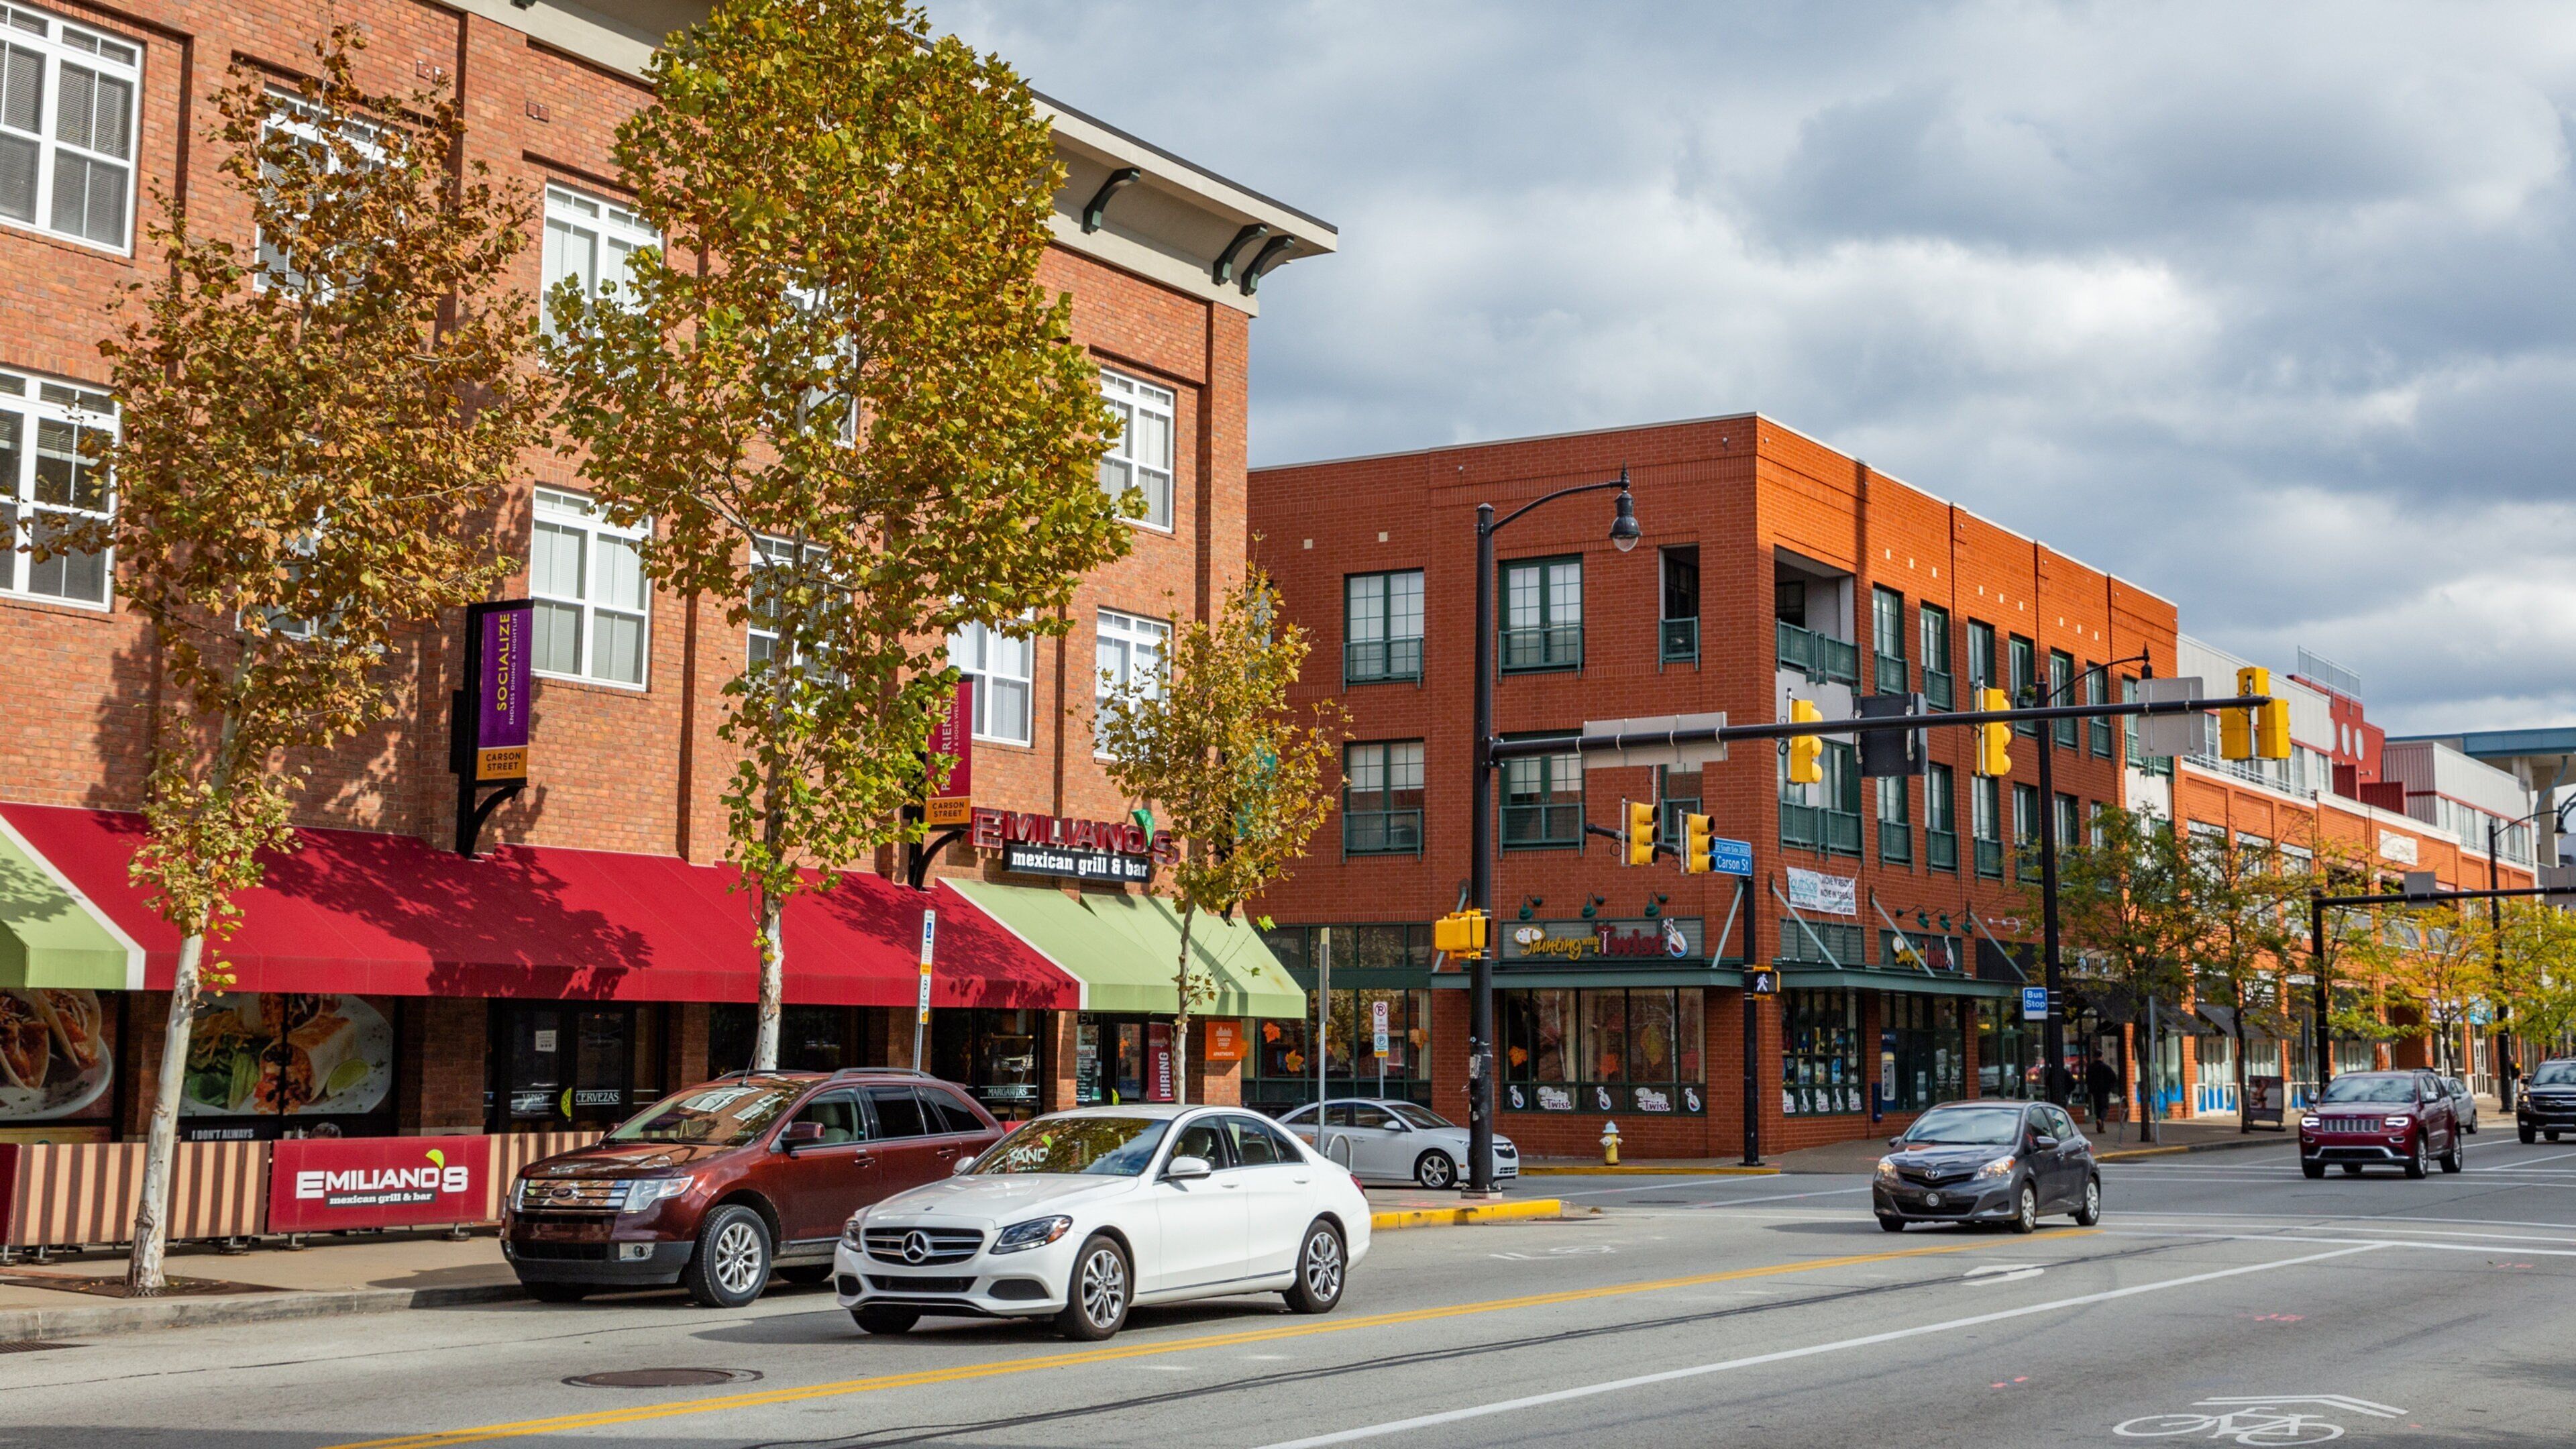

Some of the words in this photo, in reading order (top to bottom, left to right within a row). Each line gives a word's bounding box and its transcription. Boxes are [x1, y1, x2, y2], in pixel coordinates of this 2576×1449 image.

[496, 613, 511, 711] SOCIALIZE
[486, 752, 521, 761] CARSON
[487, 762, 519, 771] STREET
[934, 810, 962, 818] STREET
[971, 806, 1181, 865] EMILIANO'S
[1012, 851, 1073, 871] mexican
[1078, 856, 1107, 875] grill
[1111, 861, 1121, 875] &
[1125, 859, 1147, 877] bar
[1717, 855, 1740, 870] Carson
[1741, 859, 1749, 871] St
[1514, 926, 1582, 961] Painting
[1582, 936, 1599, 945] with
[1595, 925, 1665, 956] Twist
[1594, 945, 1599, 953] a
[2027, 990, 2043, 998] Bus
[2026, 1000, 2045, 1009] Stop
[1159, 1052, 1171, 1097] HIRING
[576, 1092, 619, 1102] CERVEZAS
[987, 1087, 1027, 1096] MARGARITAS
[522, 1093, 545, 1104] VINO
[1546, 1098, 1569, 1109] Twist
[1644, 1099, 1668, 1110] Twist
[192, 1130, 196, 1140] I
[197, 1129, 221, 1140] DON'T
[221, 1128, 254, 1139] ALWAYS
[296, 1166, 468, 1199] EMILIANO'S
[329, 1194, 376, 1204] mexican
[378, 1193, 401, 1204] grill
[413, 1192, 432, 1201] bar
